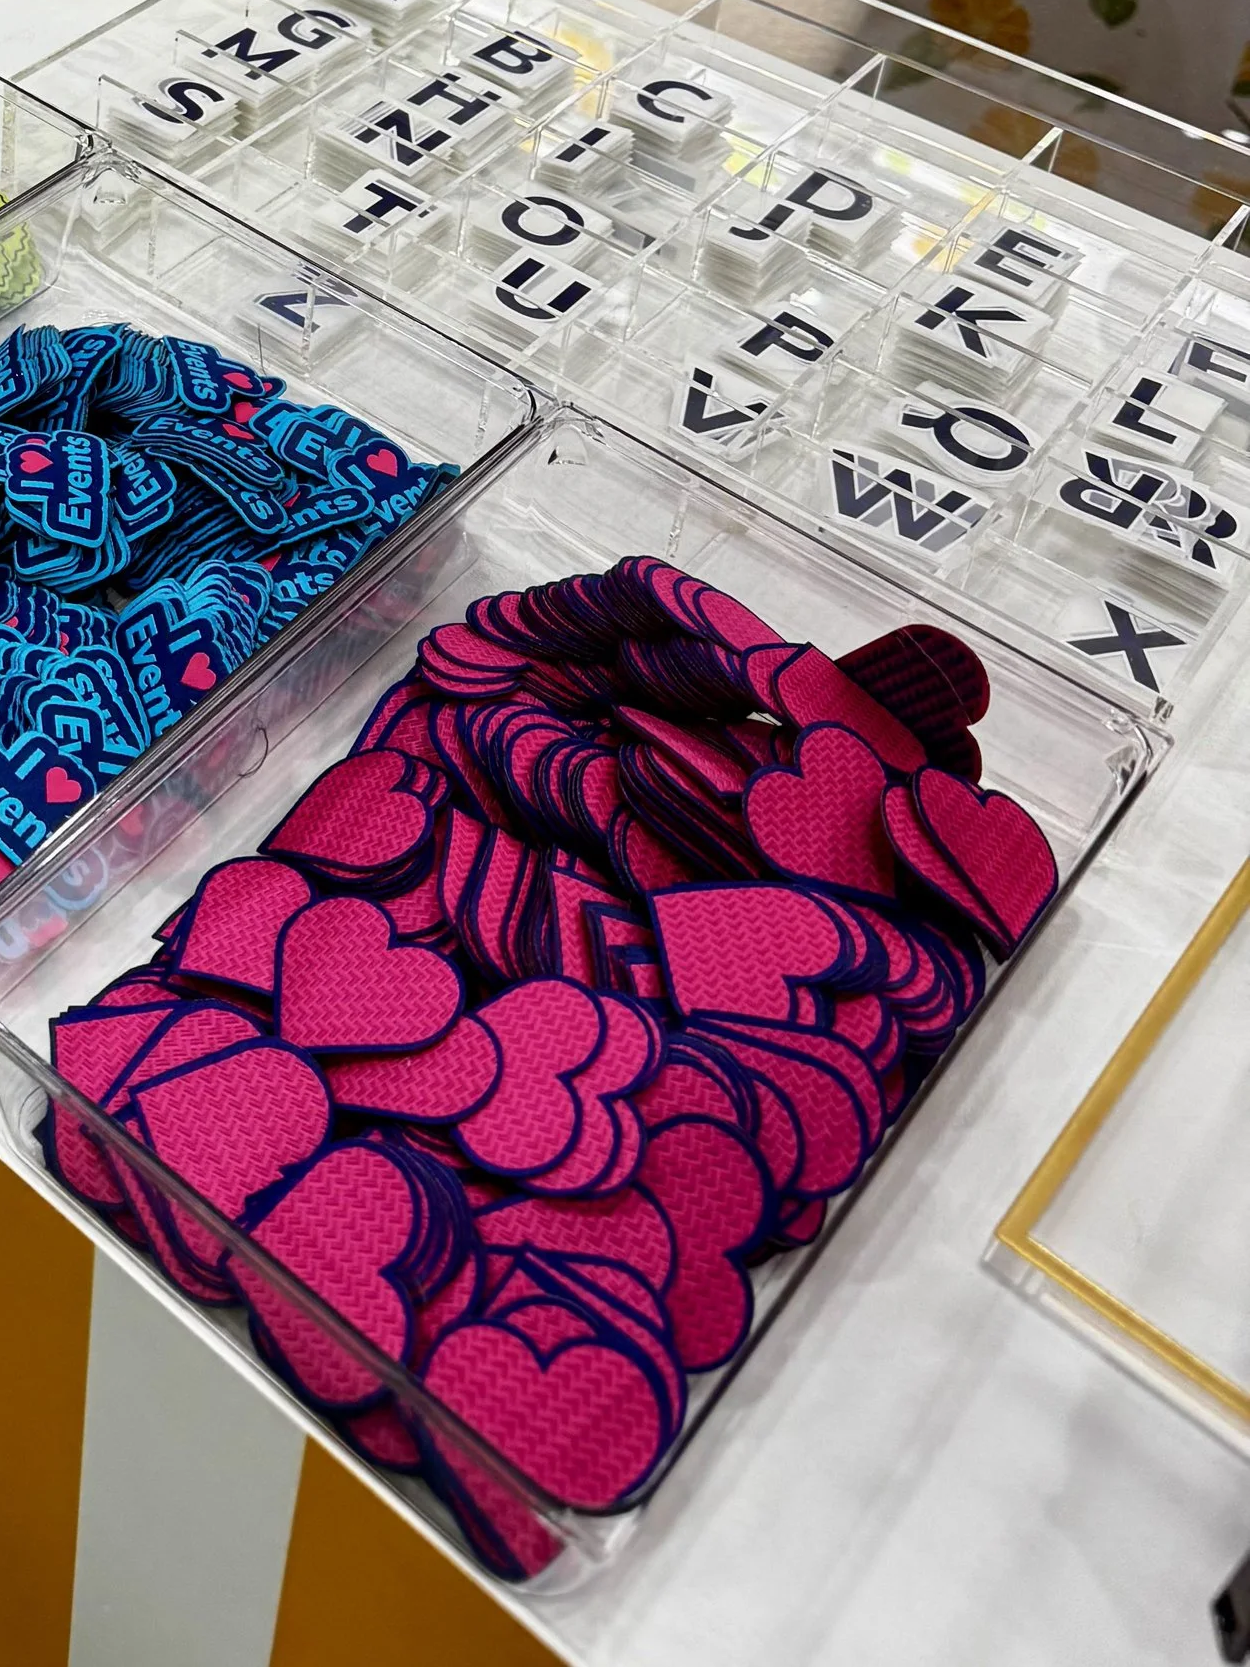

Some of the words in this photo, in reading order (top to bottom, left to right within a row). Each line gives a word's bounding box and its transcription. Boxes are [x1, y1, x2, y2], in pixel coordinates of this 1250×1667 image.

[201, 27, 301, 80] M
[277, 9, 352, 50] G
[473, 30, 553, 75] B
[142, 79, 225, 124] S
[407, 73, 502, 126] H
[636, 80, 713, 124] C
[354, 107, 452, 167] N
[343, 181, 427, 234] T
[501, 196, 585, 247] O
[729, 203, 795, 241] J
[785, 169, 874, 221] D
[973, 228, 1063, 287] E
[495, 257, 592, 321] U
[739, 311, 835, 363] P
[915, 285, 1027, 358] K
[177, 340, 218, 403] Events
[682, 366, 785, 434] V
[1112, 376, 1178, 445] L
[148, 416, 272, 472] Events
[901, 406, 1035, 472] Q
[20, 479, 54, 490] I
[58, 435, 92, 530] Events
[831, 448, 974, 543] W
[1066, 599, 1187, 693] X
